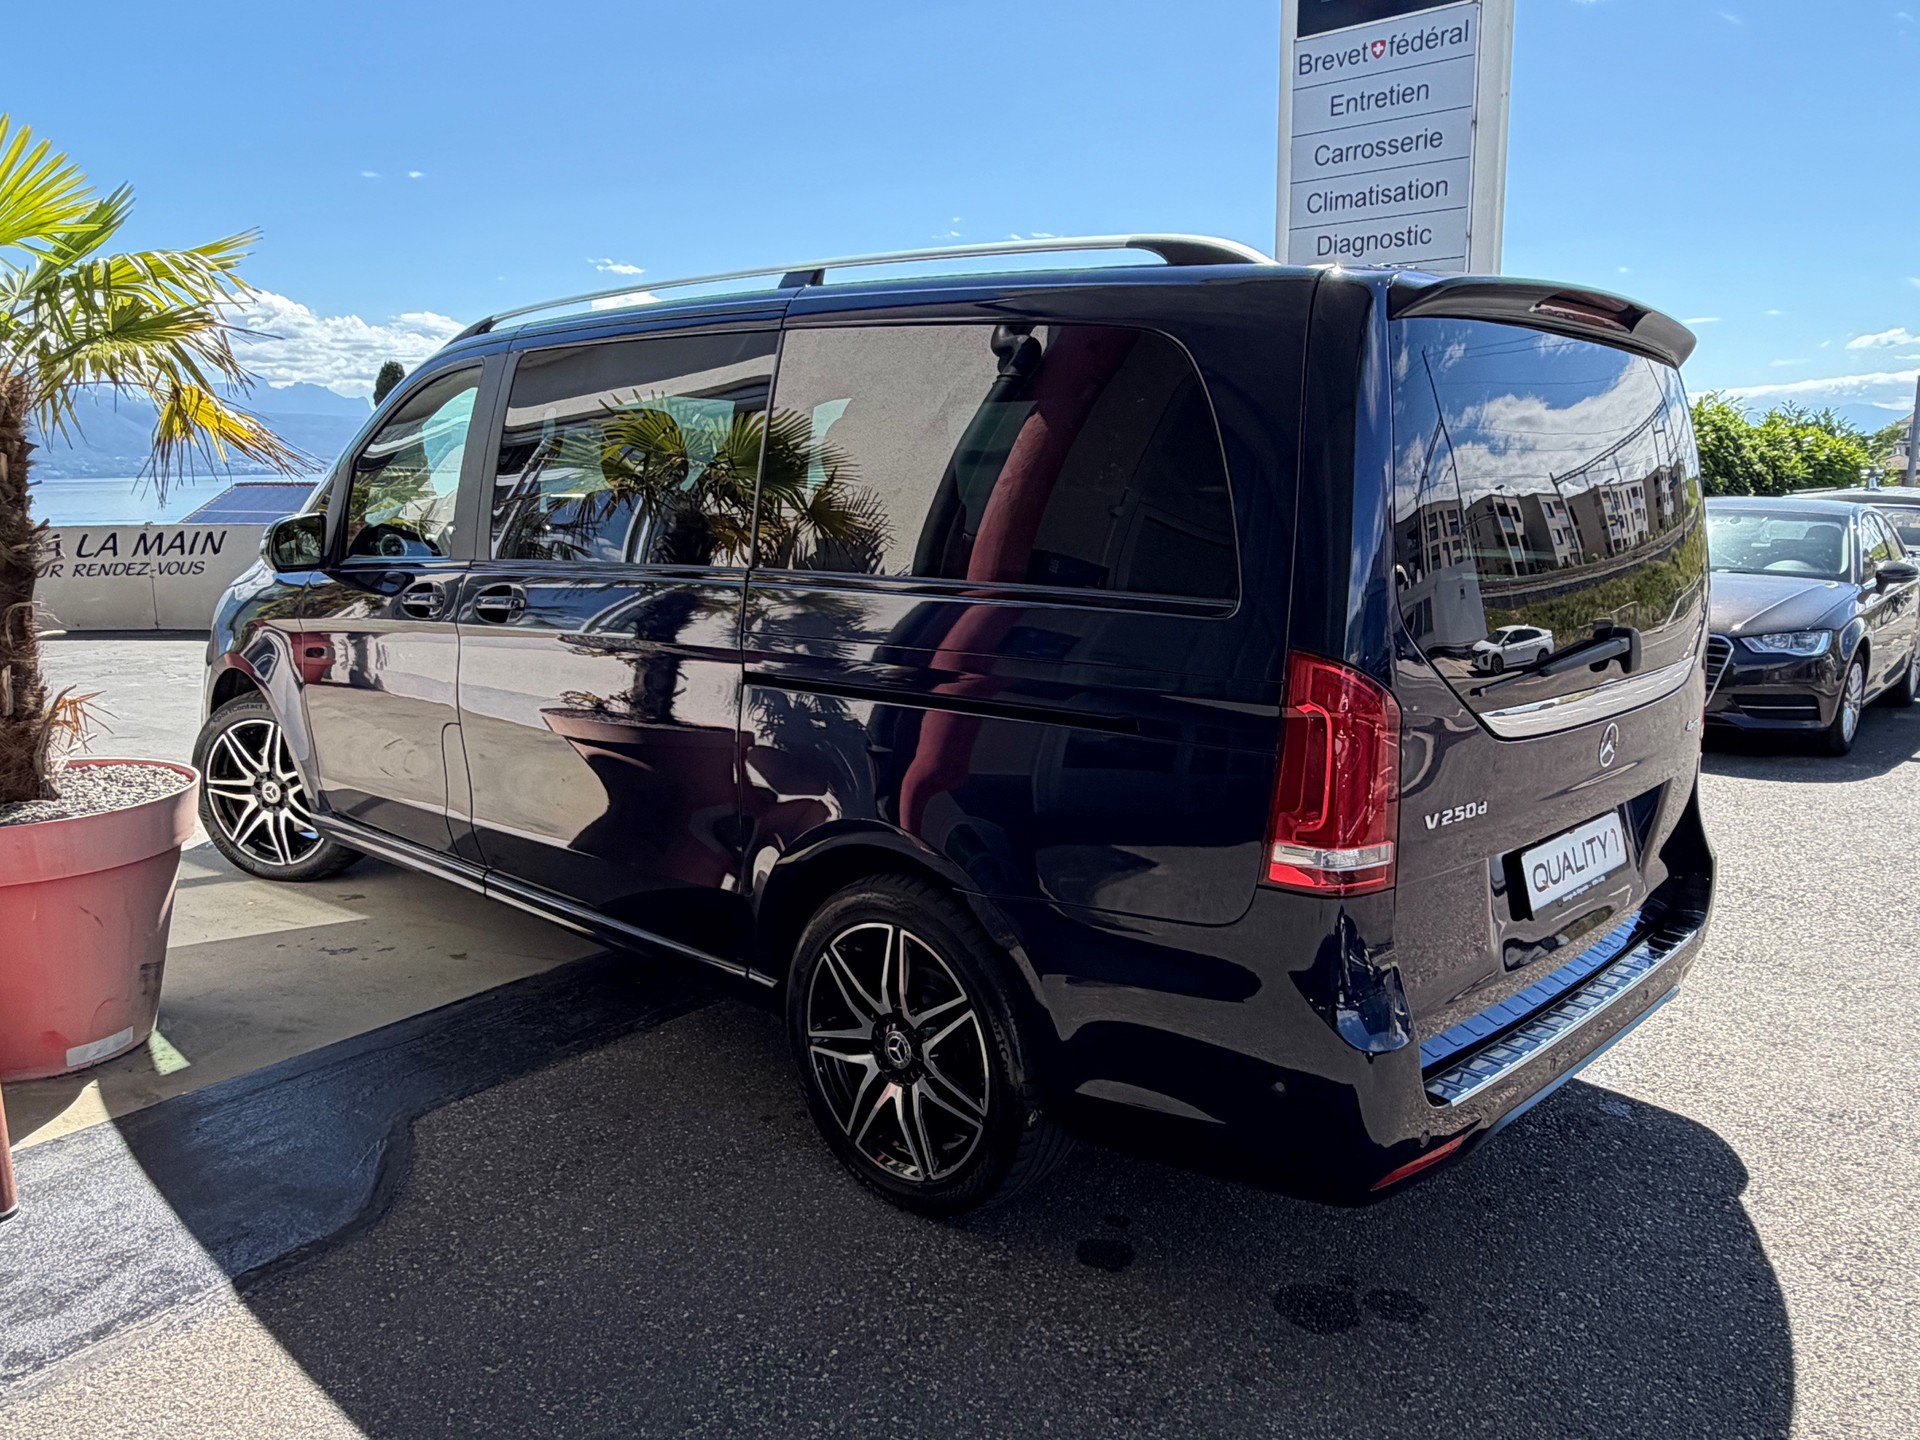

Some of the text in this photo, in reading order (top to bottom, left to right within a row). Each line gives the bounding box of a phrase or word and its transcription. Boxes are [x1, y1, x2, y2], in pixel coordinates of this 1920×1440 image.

[1299, 19, 1469, 75] Brevet fédéral
[1330, 83, 1430, 117] Entretien
[1314, 128, 1444, 166] Carrosserie
[1306, 178, 1449, 214] Climatisation
[1316, 225, 1432, 257] Diagnostic
[76, 532, 118, 558] LA
[131, 530, 227, 557] MAIN
[72, 561, 205, 577] RENDEZ-VOUS
[1533, 831, 1607, 893] QUALITY
